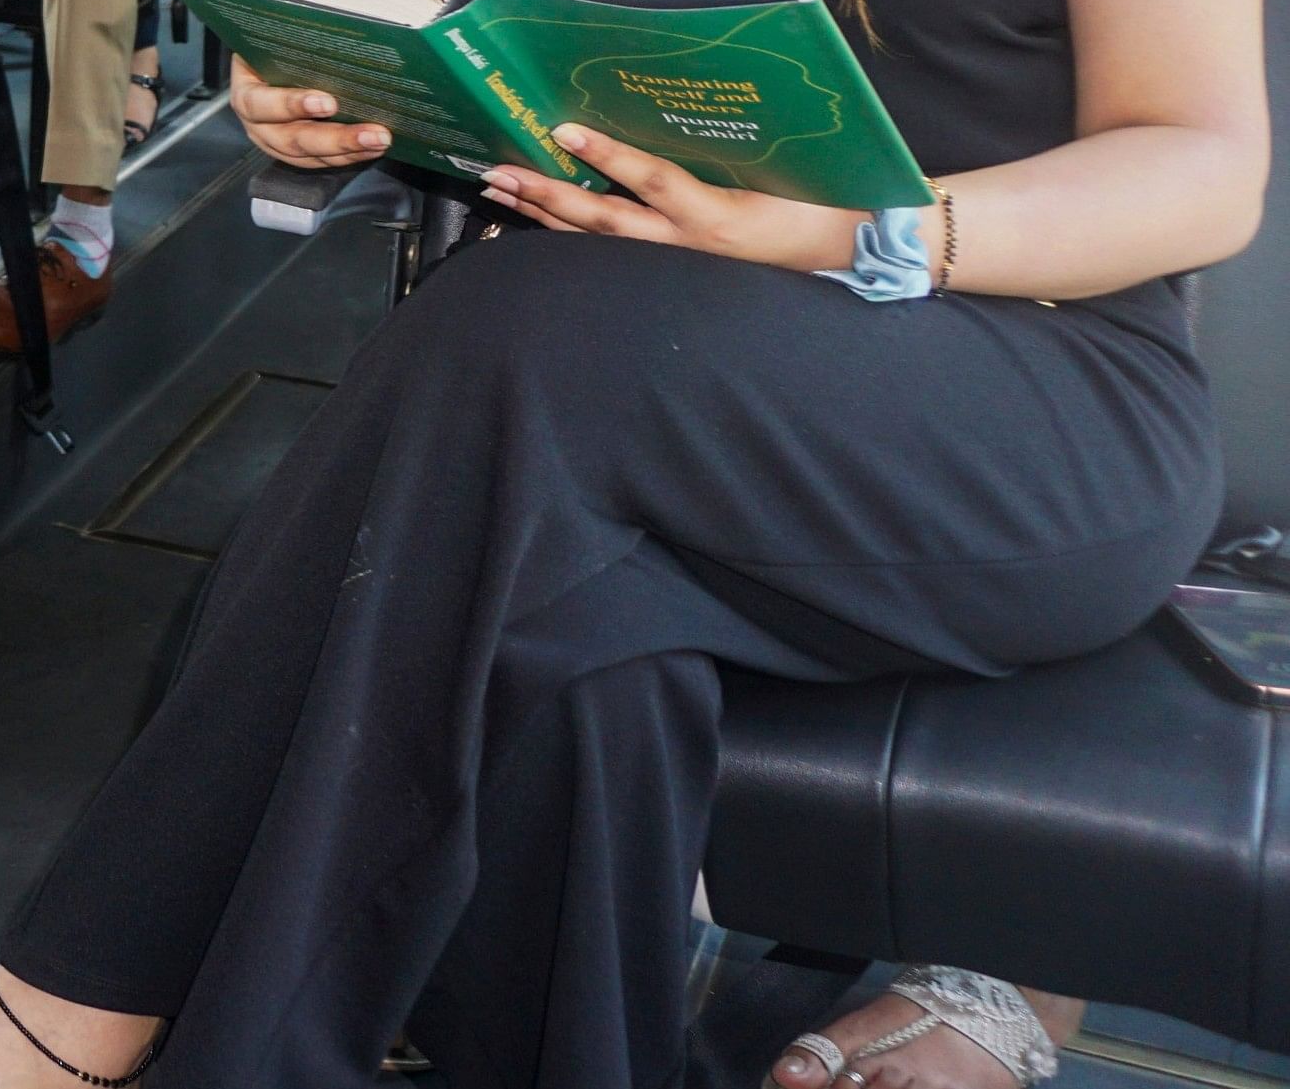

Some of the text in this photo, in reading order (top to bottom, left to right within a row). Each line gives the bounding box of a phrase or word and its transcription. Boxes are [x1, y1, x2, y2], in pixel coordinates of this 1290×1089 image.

[611, 68, 757, 93] Translating
[621, 82, 762, 103] Myself and
[655, 99, 746, 114] Others
[485, 70, 526, 119] Translating
[553, 147, 578, 177] Others
[661, 113, 760, 131] Jhumpa
[681, 126, 759, 141] Lahiri
